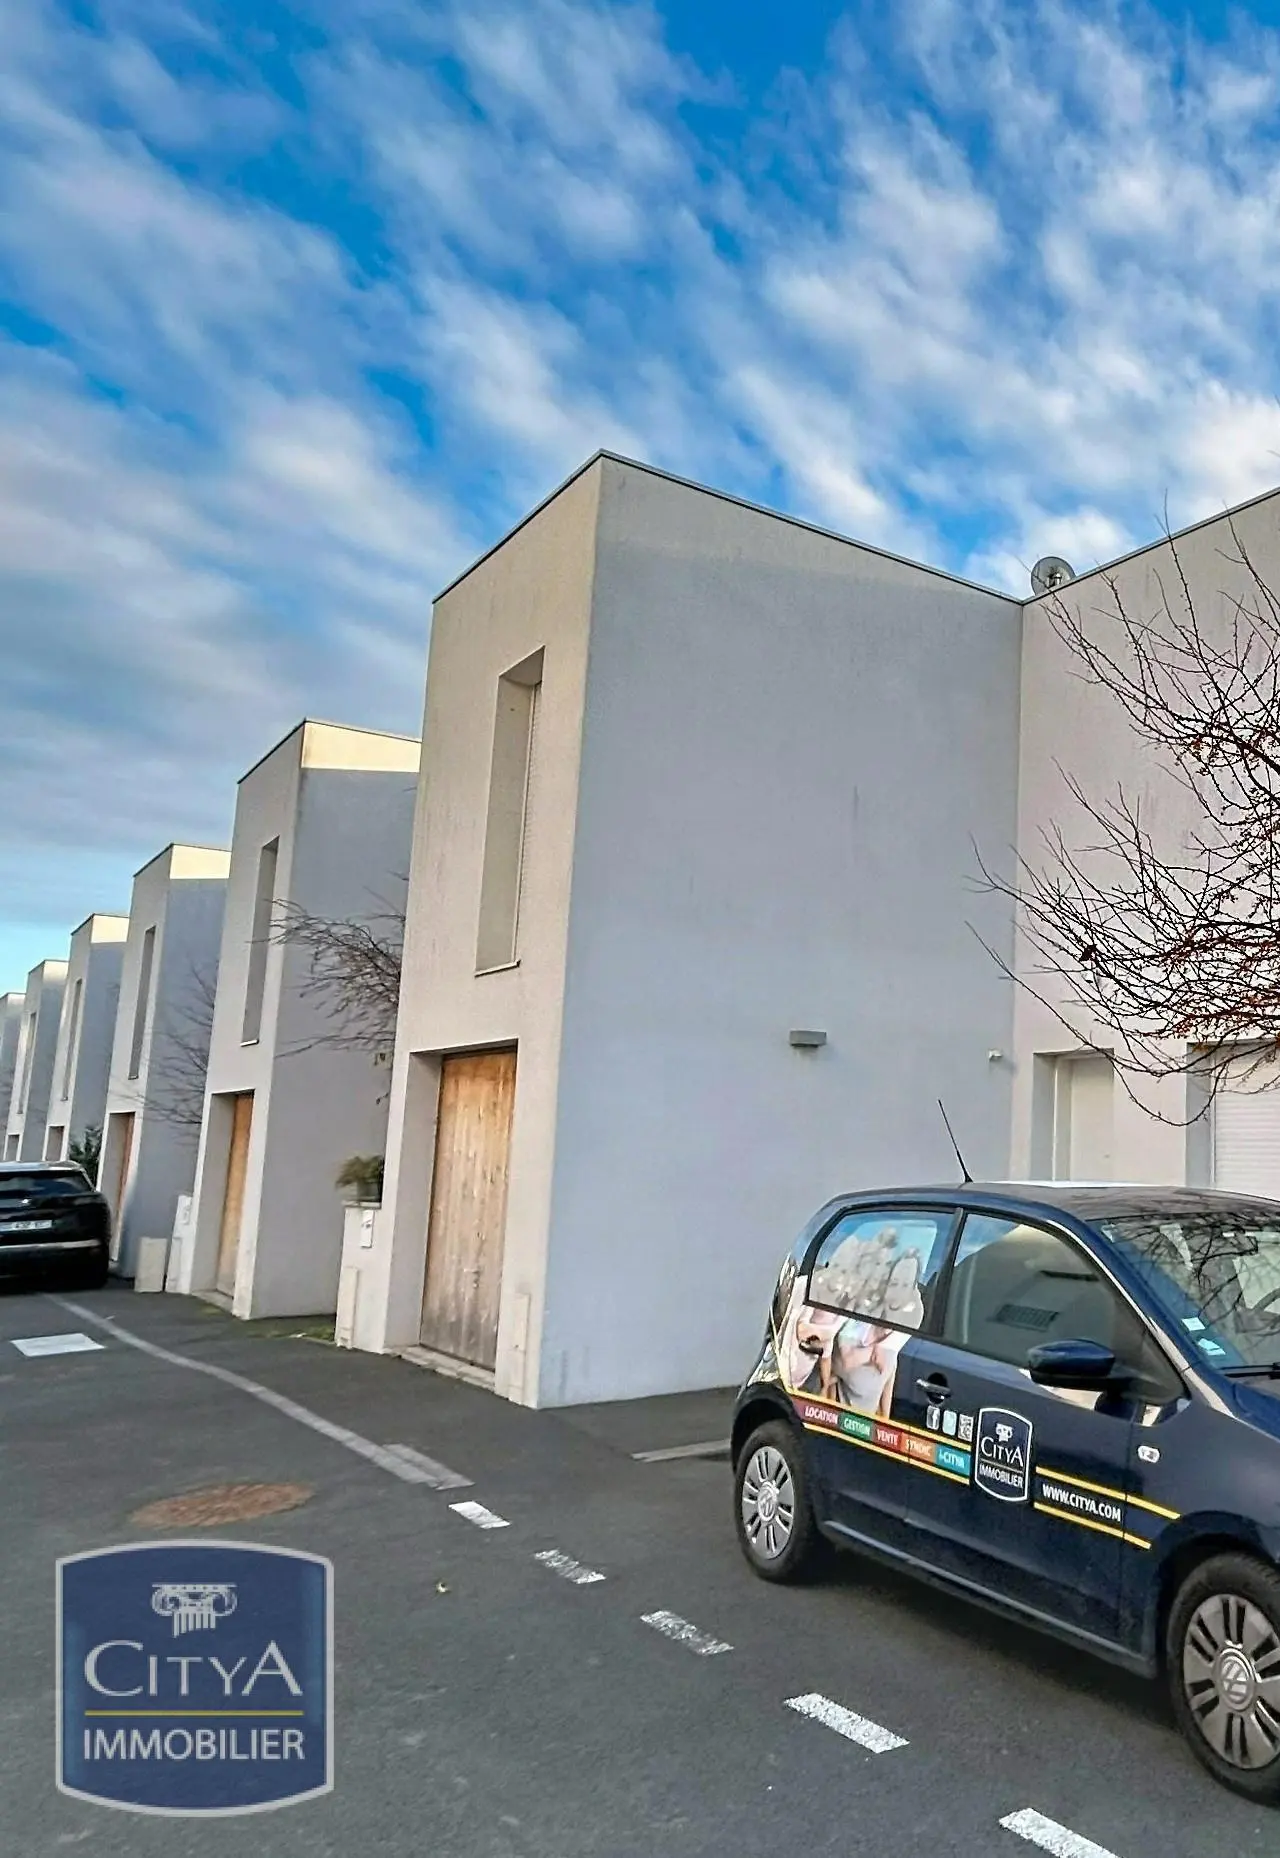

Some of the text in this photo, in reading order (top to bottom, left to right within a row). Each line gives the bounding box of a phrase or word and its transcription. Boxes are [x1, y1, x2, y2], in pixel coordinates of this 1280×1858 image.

[805, 1405, 838, 1425] LOCATION
[843, 1418, 872, 1437] GESTION
[876, 1428, 899, 1446] VENTE
[979, 1463, 1023, 1489] IMMOBILIER
[1042, 1483, 1122, 1522] WWW.CITYA.COM
